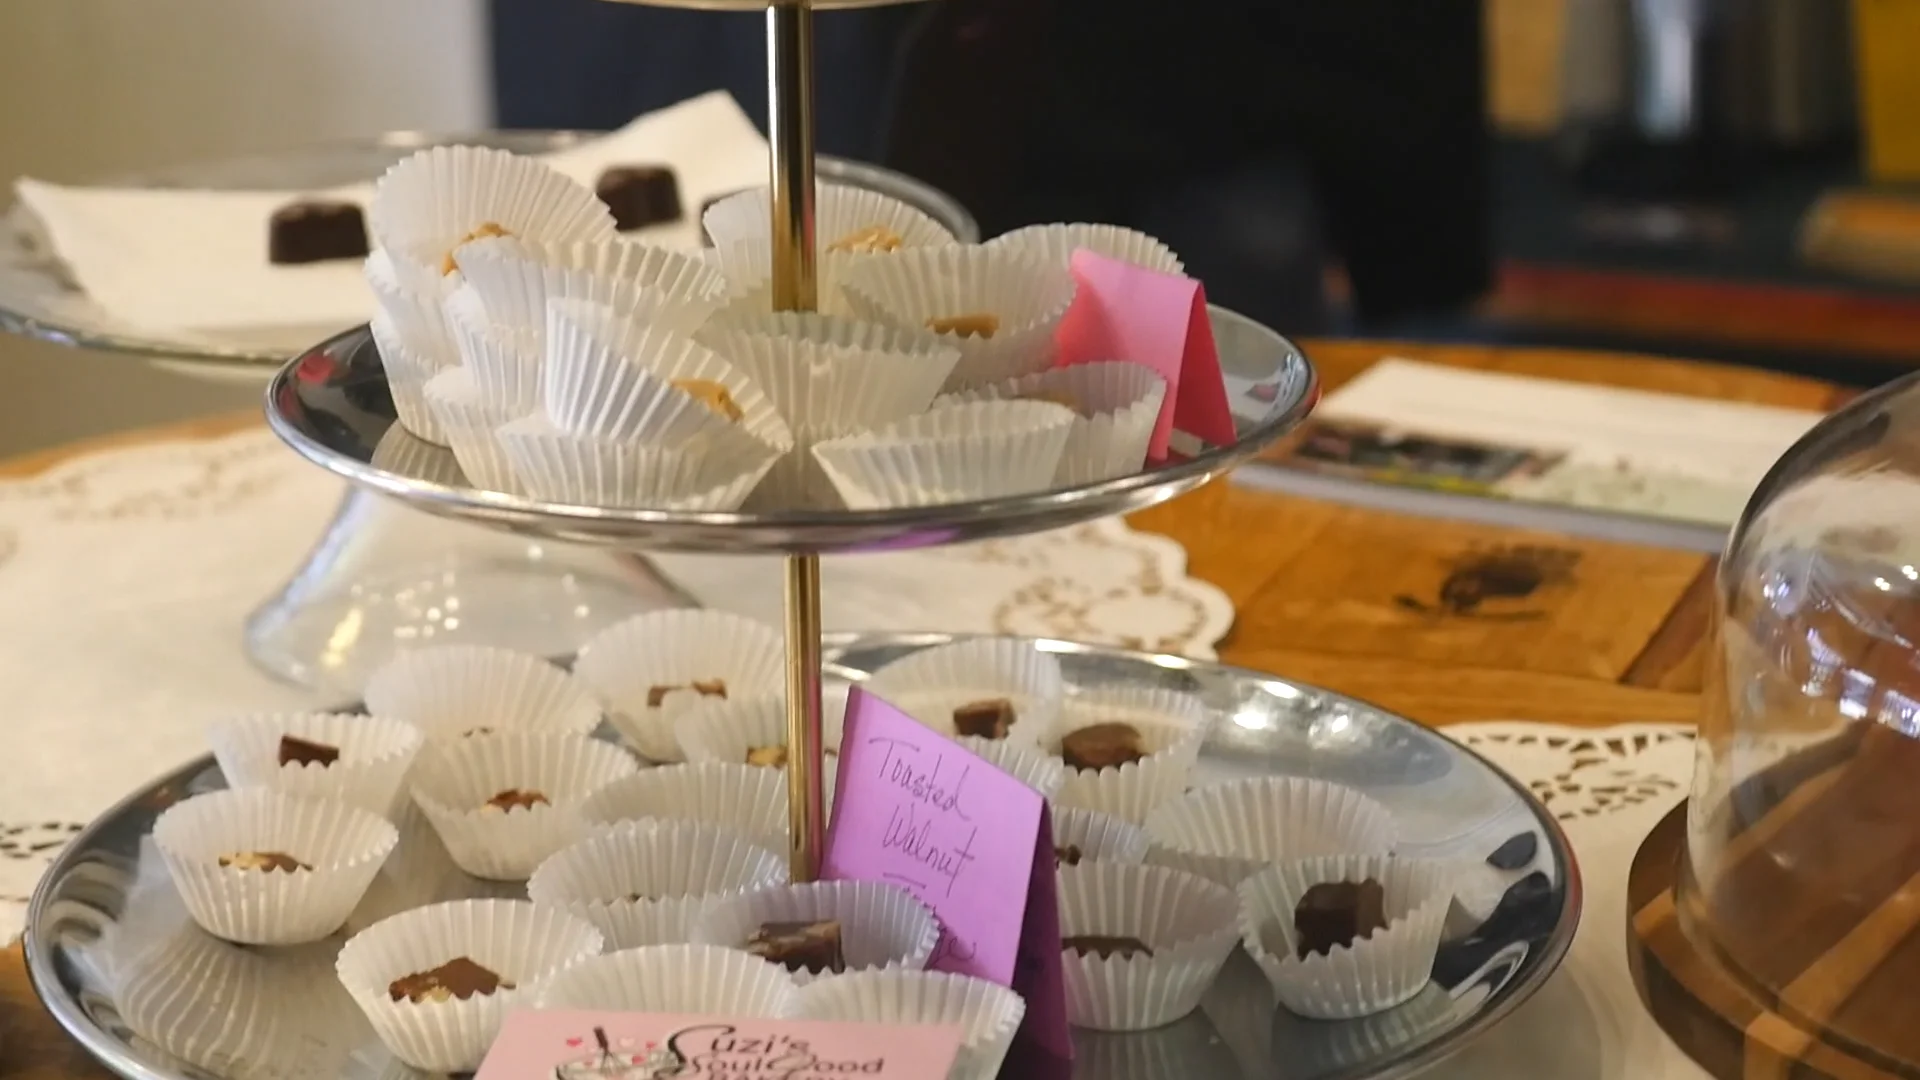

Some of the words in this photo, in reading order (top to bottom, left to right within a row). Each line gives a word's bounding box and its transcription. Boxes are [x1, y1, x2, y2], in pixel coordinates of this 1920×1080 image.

[868, 737, 972, 821] Toasted
[882, 802, 977, 898] Walnut
[656, 1024, 810, 1073] Suzi's
